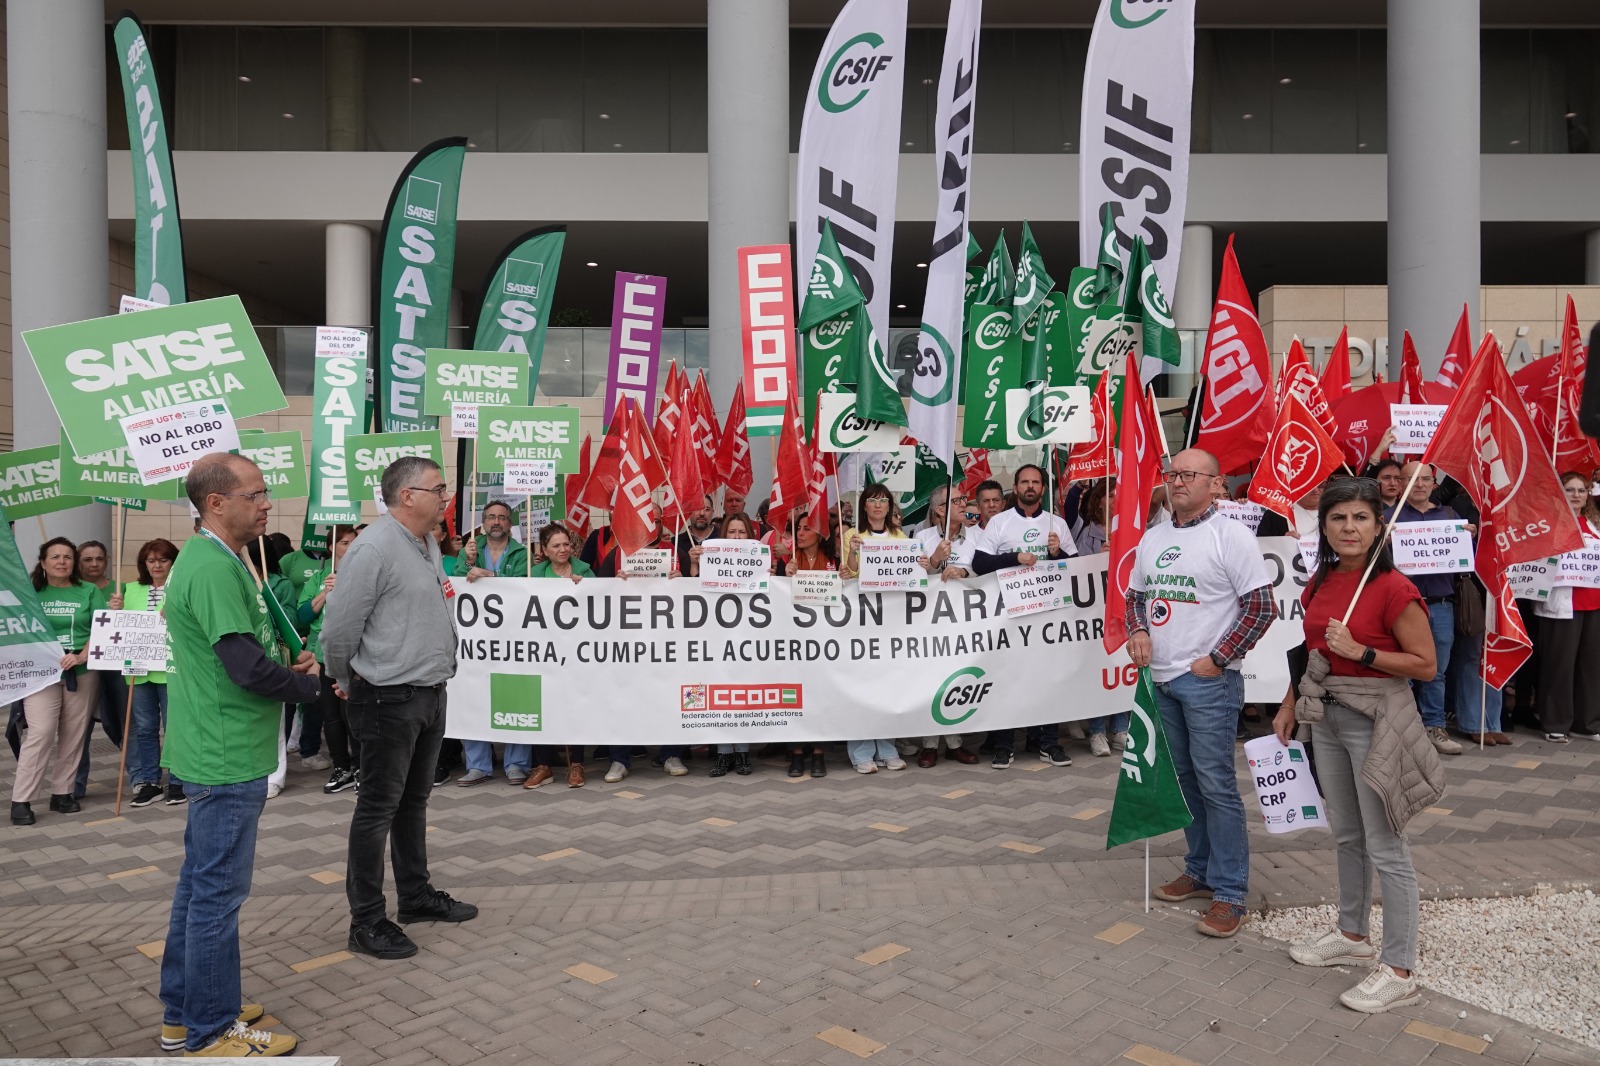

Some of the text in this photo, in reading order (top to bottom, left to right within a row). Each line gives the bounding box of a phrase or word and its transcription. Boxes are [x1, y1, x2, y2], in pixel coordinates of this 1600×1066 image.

[833, 56, 893, 87] CSIF
[1099, 79, 1173, 261] CSIF
[407, 204, 435, 221] SATSE
[506, 282, 537, 296] SATSE
[390, 225, 436, 418] SATSE
[747, 252, 788, 402] CCOO
[818, 320, 854, 336] CSIF
[65, 323, 245, 392] SATSE
[615, 282, 656, 418] CCOO
[436, 362, 519, 390] SATSE
[103, 372, 245, 421] ALMERÍA
[442, 389, 511, 404] ALMERÍA
[980, 356, 1004, 442] CSIF
[156, 414, 174, 424] UGT
[139, 420, 222, 446] NO AL ROBO
[319, 357, 358, 508] SATSE
[488, 419, 570, 444] SATSE
[1410, 430, 1425, 438] DEL
[162, 437, 216, 458] DEL CRP
[494, 444, 562, 459] ALMERÍA
[172, 461, 191, 472] UGT
[80, 469, 140, 484] ALMER
[312, 511, 357, 522] ALMERÍA
[1025, 545, 1050, 553] JUNT
[1400, 536, 1459, 547] NO AL ROBO
[866, 556, 881, 564] NO
[883, 556, 895, 564] AL
[1161, 553, 1182, 562] CSIF
[1413, 548, 1451, 558] DEL CRP
[707, 557, 763, 567] NO AL ROBO
[1511, 564, 1547, 574] AL ROBO
[1561, 563, 1598, 572] DEL CRP
[717, 569, 754, 578] DEL CRP
[877, 567, 913, 576] DEL CRP
[1019, 567, 1030, 575] UGT
[1005, 573, 1062, 591] NO AL ROBO
[1154, 574, 1196, 588] JUNTA
[1020, 586, 1055, 600] DEL CRP
[1157, 589, 1196, 602] ROBA
[457, 593, 504, 629] OS
[521, 593, 773, 631] ACUERDOS
[793, 593, 883, 628] SON
[1026, 602, 1038, 610] UGT
[461, 617, 1104, 666] NSEJERA, CUMPLE EL ACUERDO DE PRIMARIA Y CARR
[8, 667, 58, 680] Enfermería
[1102, 663, 1138, 690] UG
[713, 688, 780, 705] CCOO
[944, 682, 994, 707] CSIF
[493, 711, 539, 728] SATSE
[681, 711, 721, 720] federación
[722, 711, 732, 719] de
[734, 711, 763, 719] sanidad
[771, 710, 803, 718] sectores
[681, 719, 788, 729] sociosanitarios de Andalucía
[1256, 768, 1297, 788] ROBO
[1260, 791, 1287, 807] CRP
